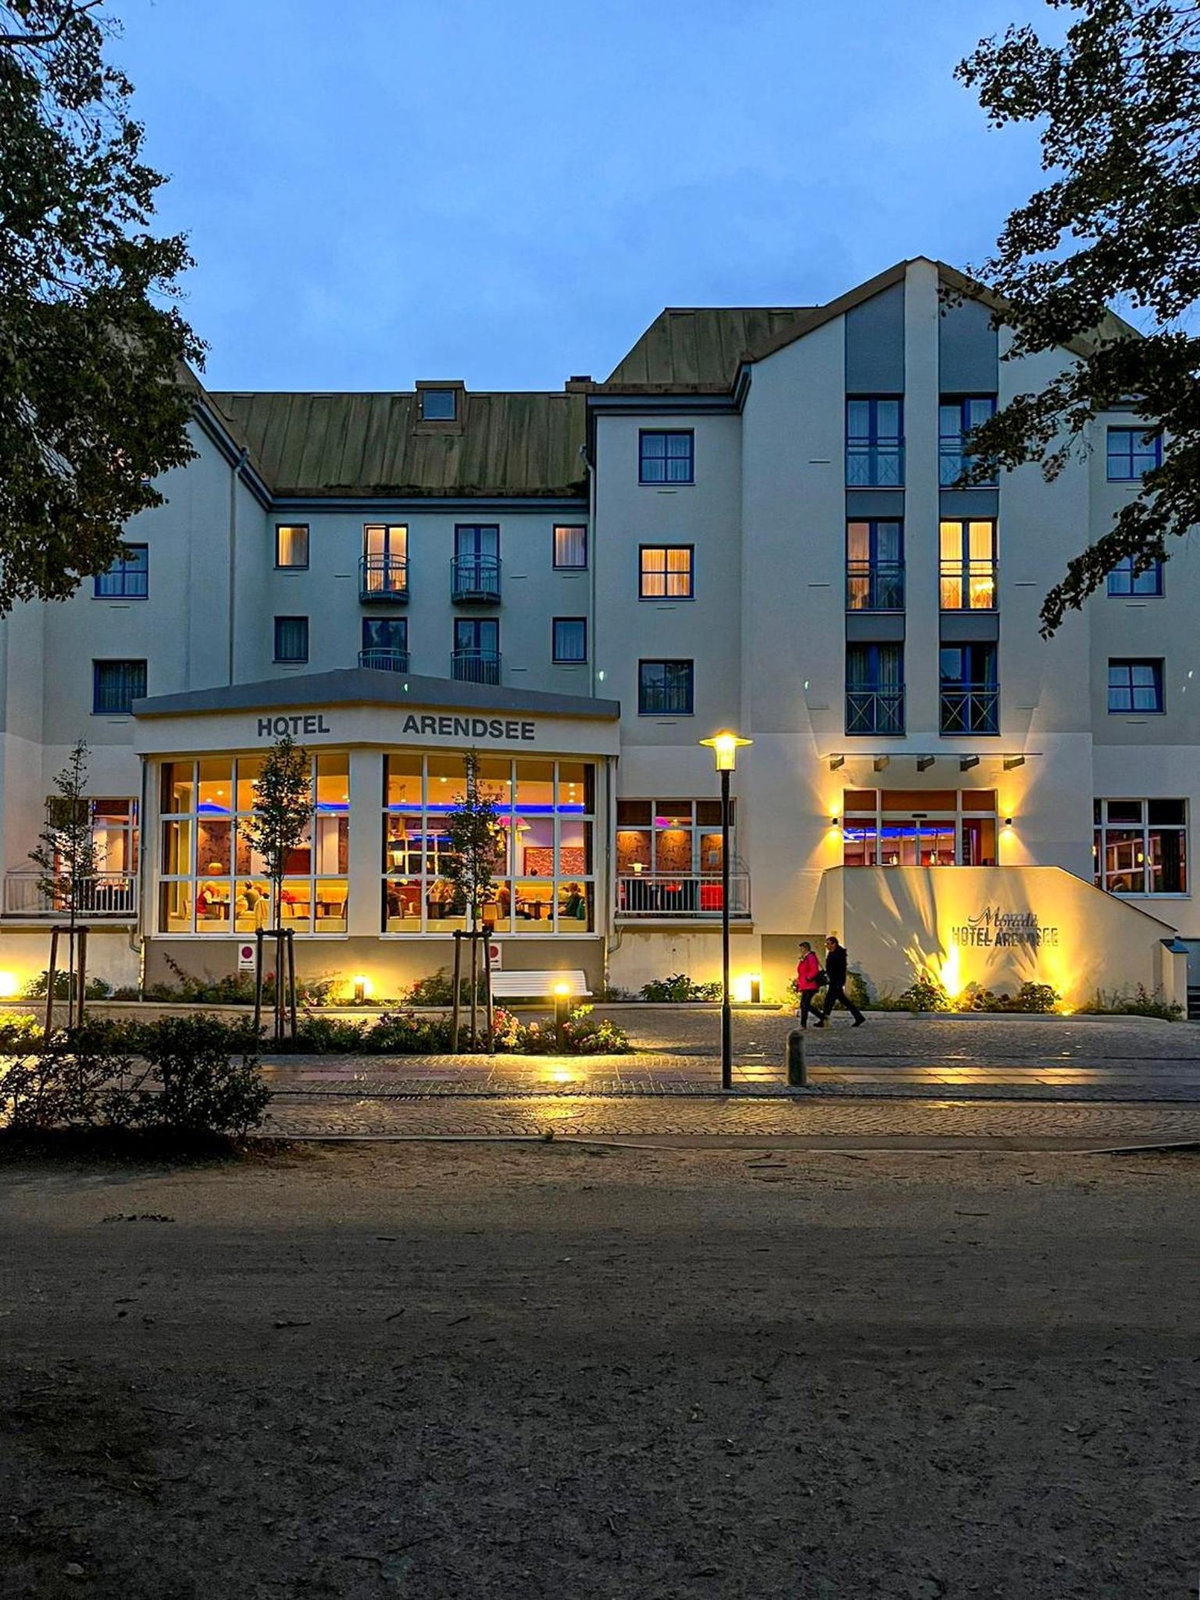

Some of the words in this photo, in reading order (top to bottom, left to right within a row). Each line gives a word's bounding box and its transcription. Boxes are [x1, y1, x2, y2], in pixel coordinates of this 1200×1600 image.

[257, 714, 330, 737] HOTEL
[402, 714, 536, 740] ARENDSEE
[952, 926, 993, 946] HOTEL
